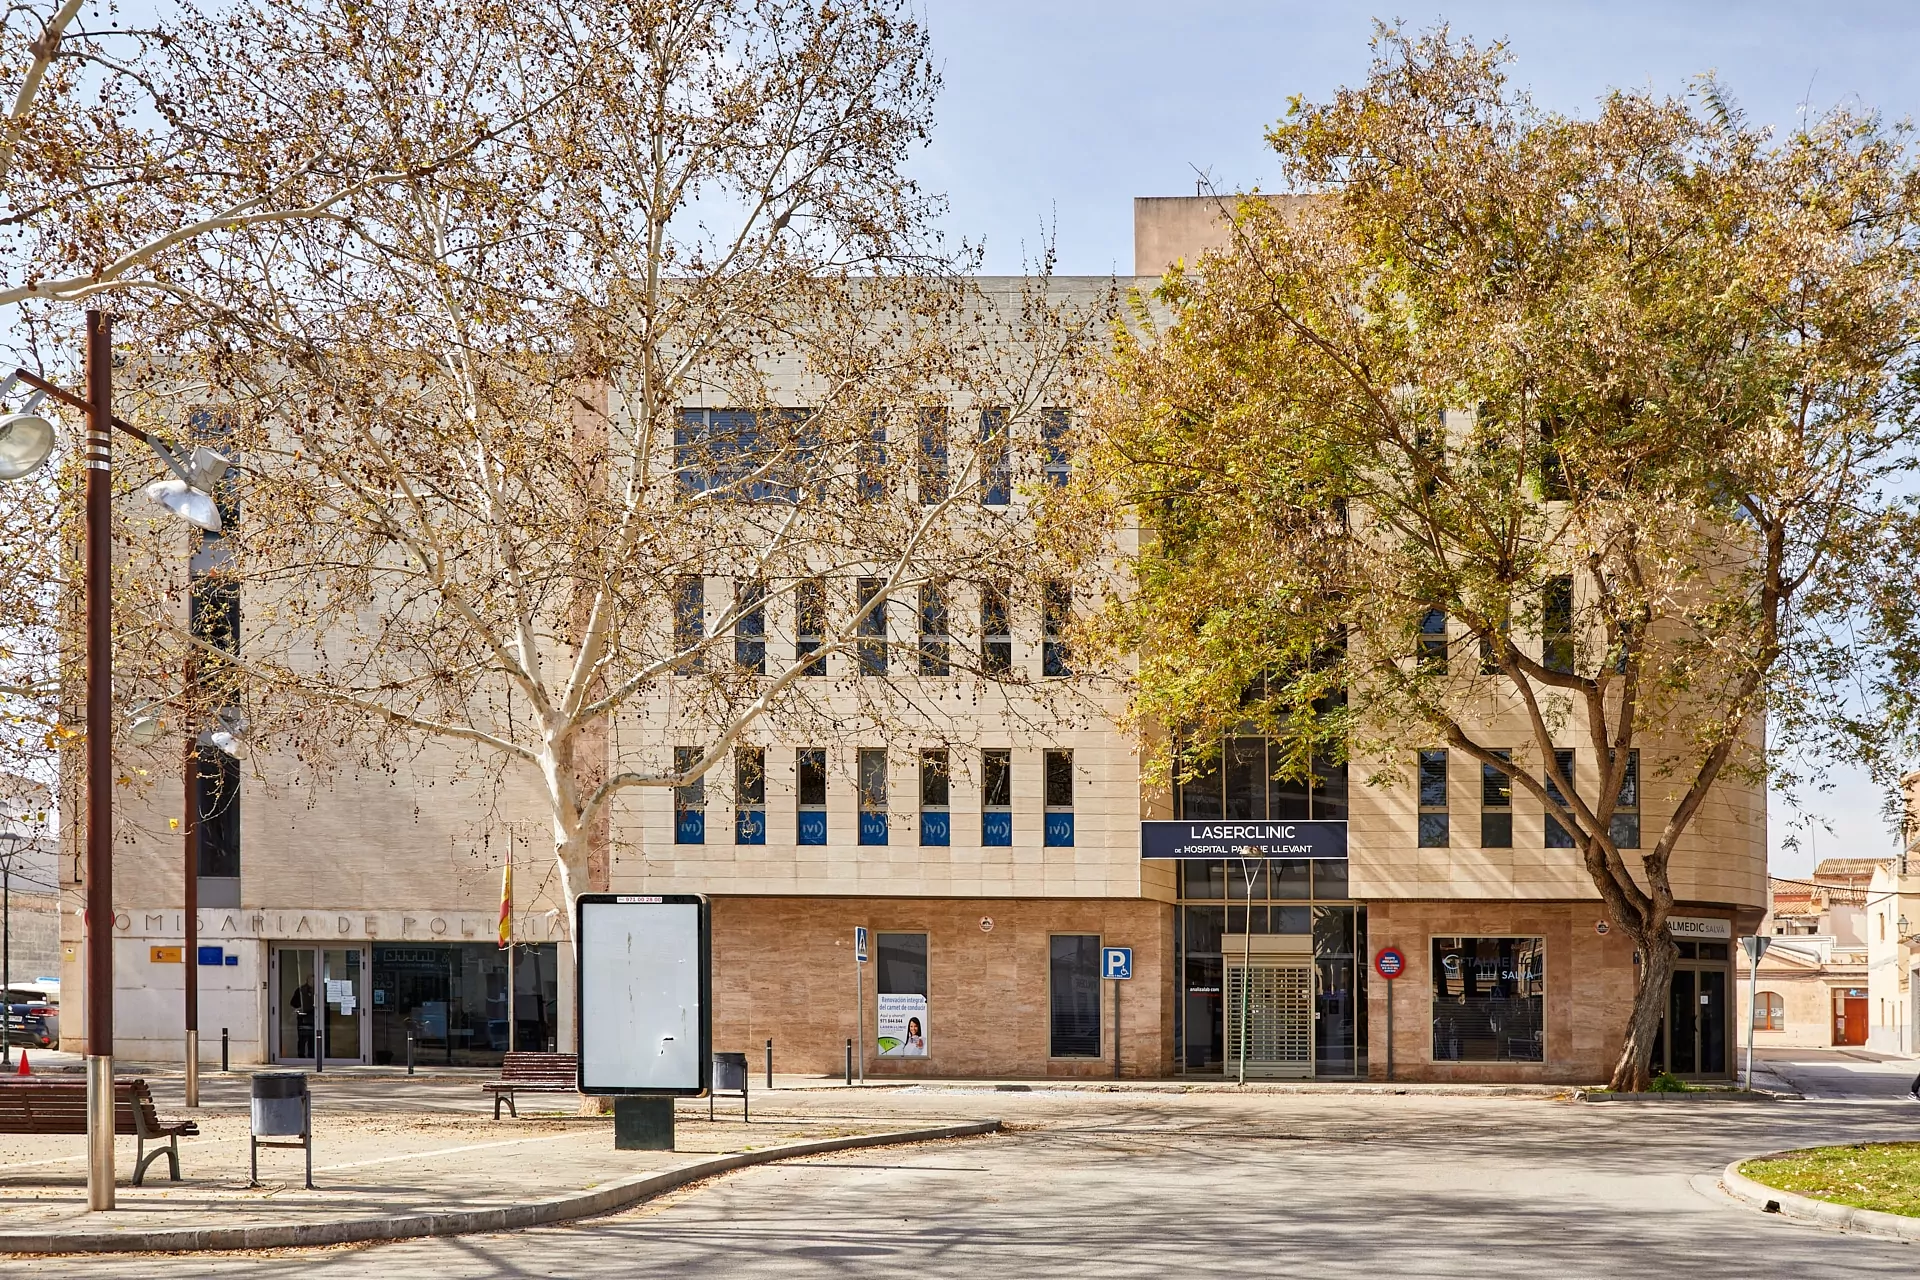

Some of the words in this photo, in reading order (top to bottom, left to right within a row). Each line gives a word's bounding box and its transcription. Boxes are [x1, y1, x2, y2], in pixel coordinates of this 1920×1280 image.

[1191, 826, 1296, 839] LASERCLINIC
[1184, 845, 1228, 853] HOSPITAL
[1231, 845, 1269, 854] PAE
[1271, 845, 1313, 853] LLEVANT
[112, 914, 313, 933] OMISARIA
[338, 916, 377, 935] DE
[403, 917, 566, 936] POLIIA
[1666, 920, 1705, 933] ALMEDIC
[1705, 924, 1725, 934] SALVÀ
[1108, 951, 1125, 975] P
